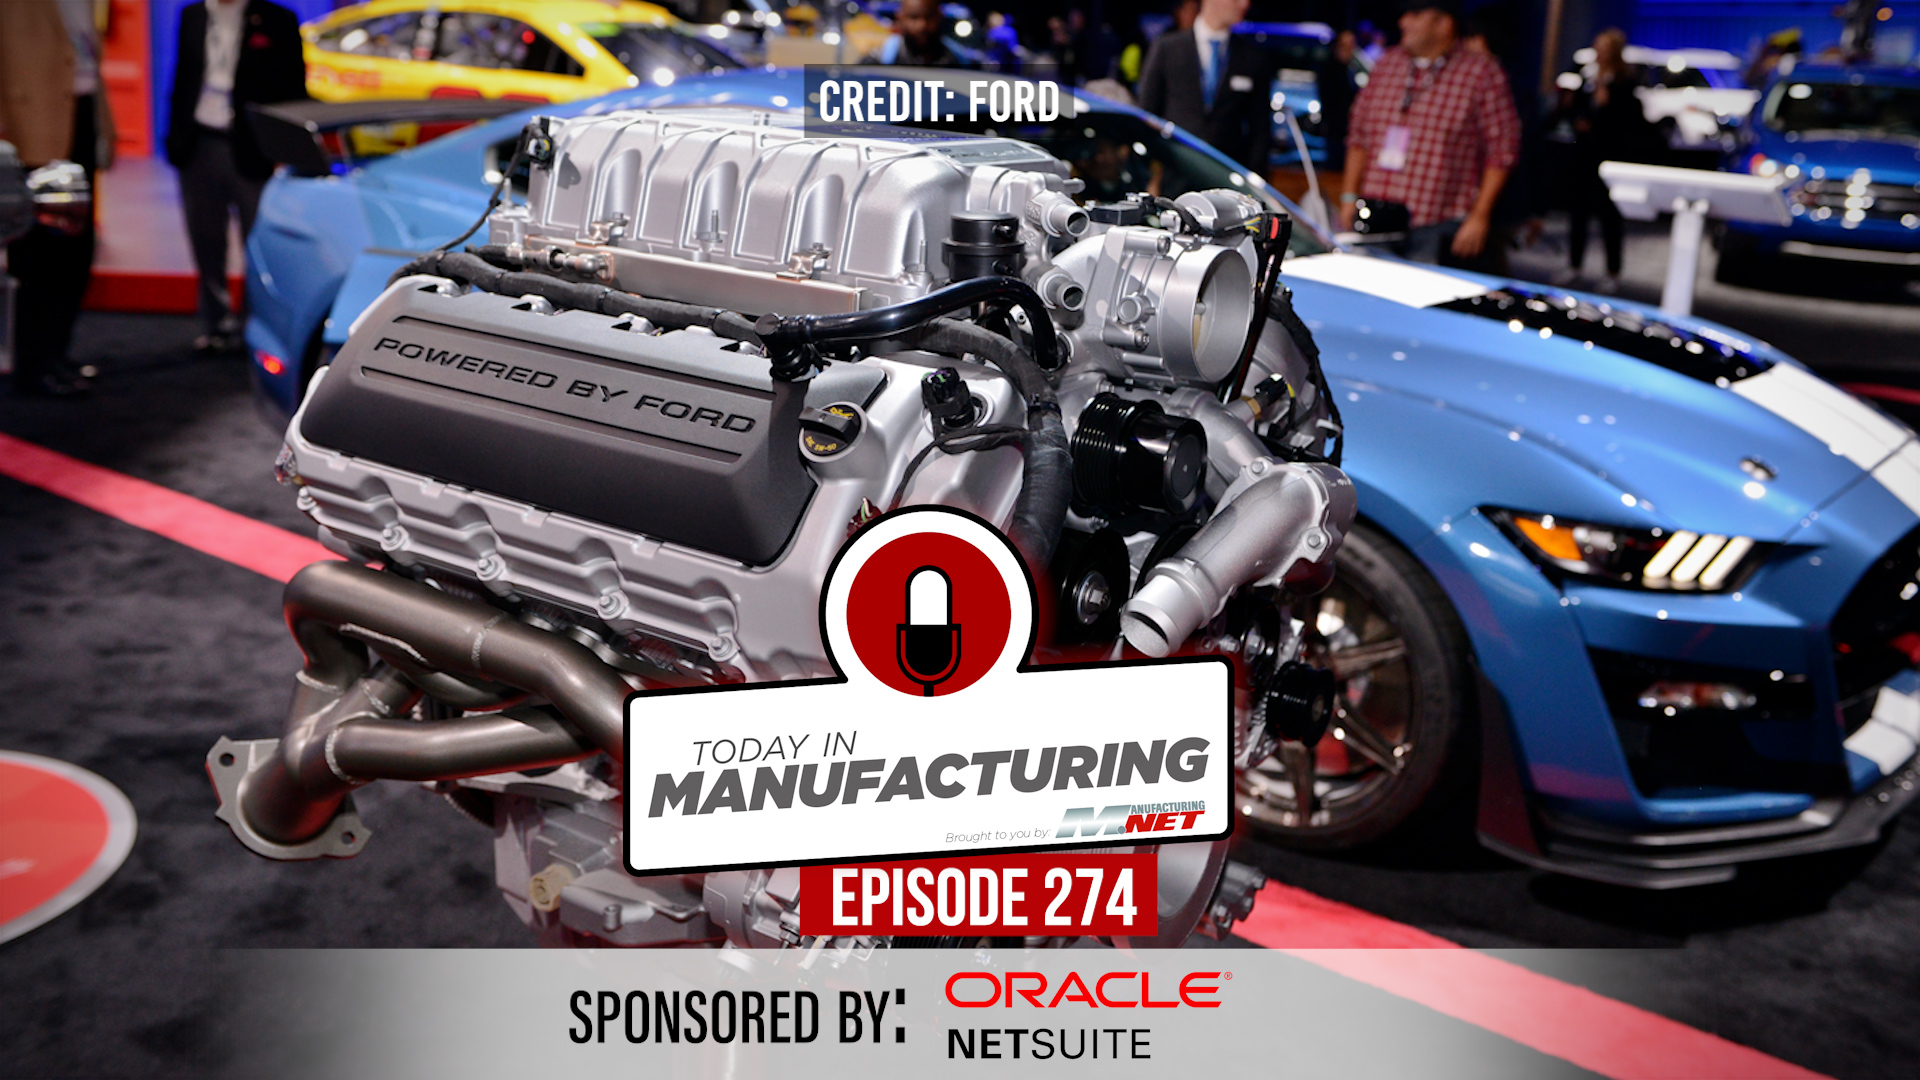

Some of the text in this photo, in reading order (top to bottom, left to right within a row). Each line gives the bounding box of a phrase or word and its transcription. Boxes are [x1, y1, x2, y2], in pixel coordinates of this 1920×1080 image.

[374, 337, 757, 433] POWERED BY FORD
